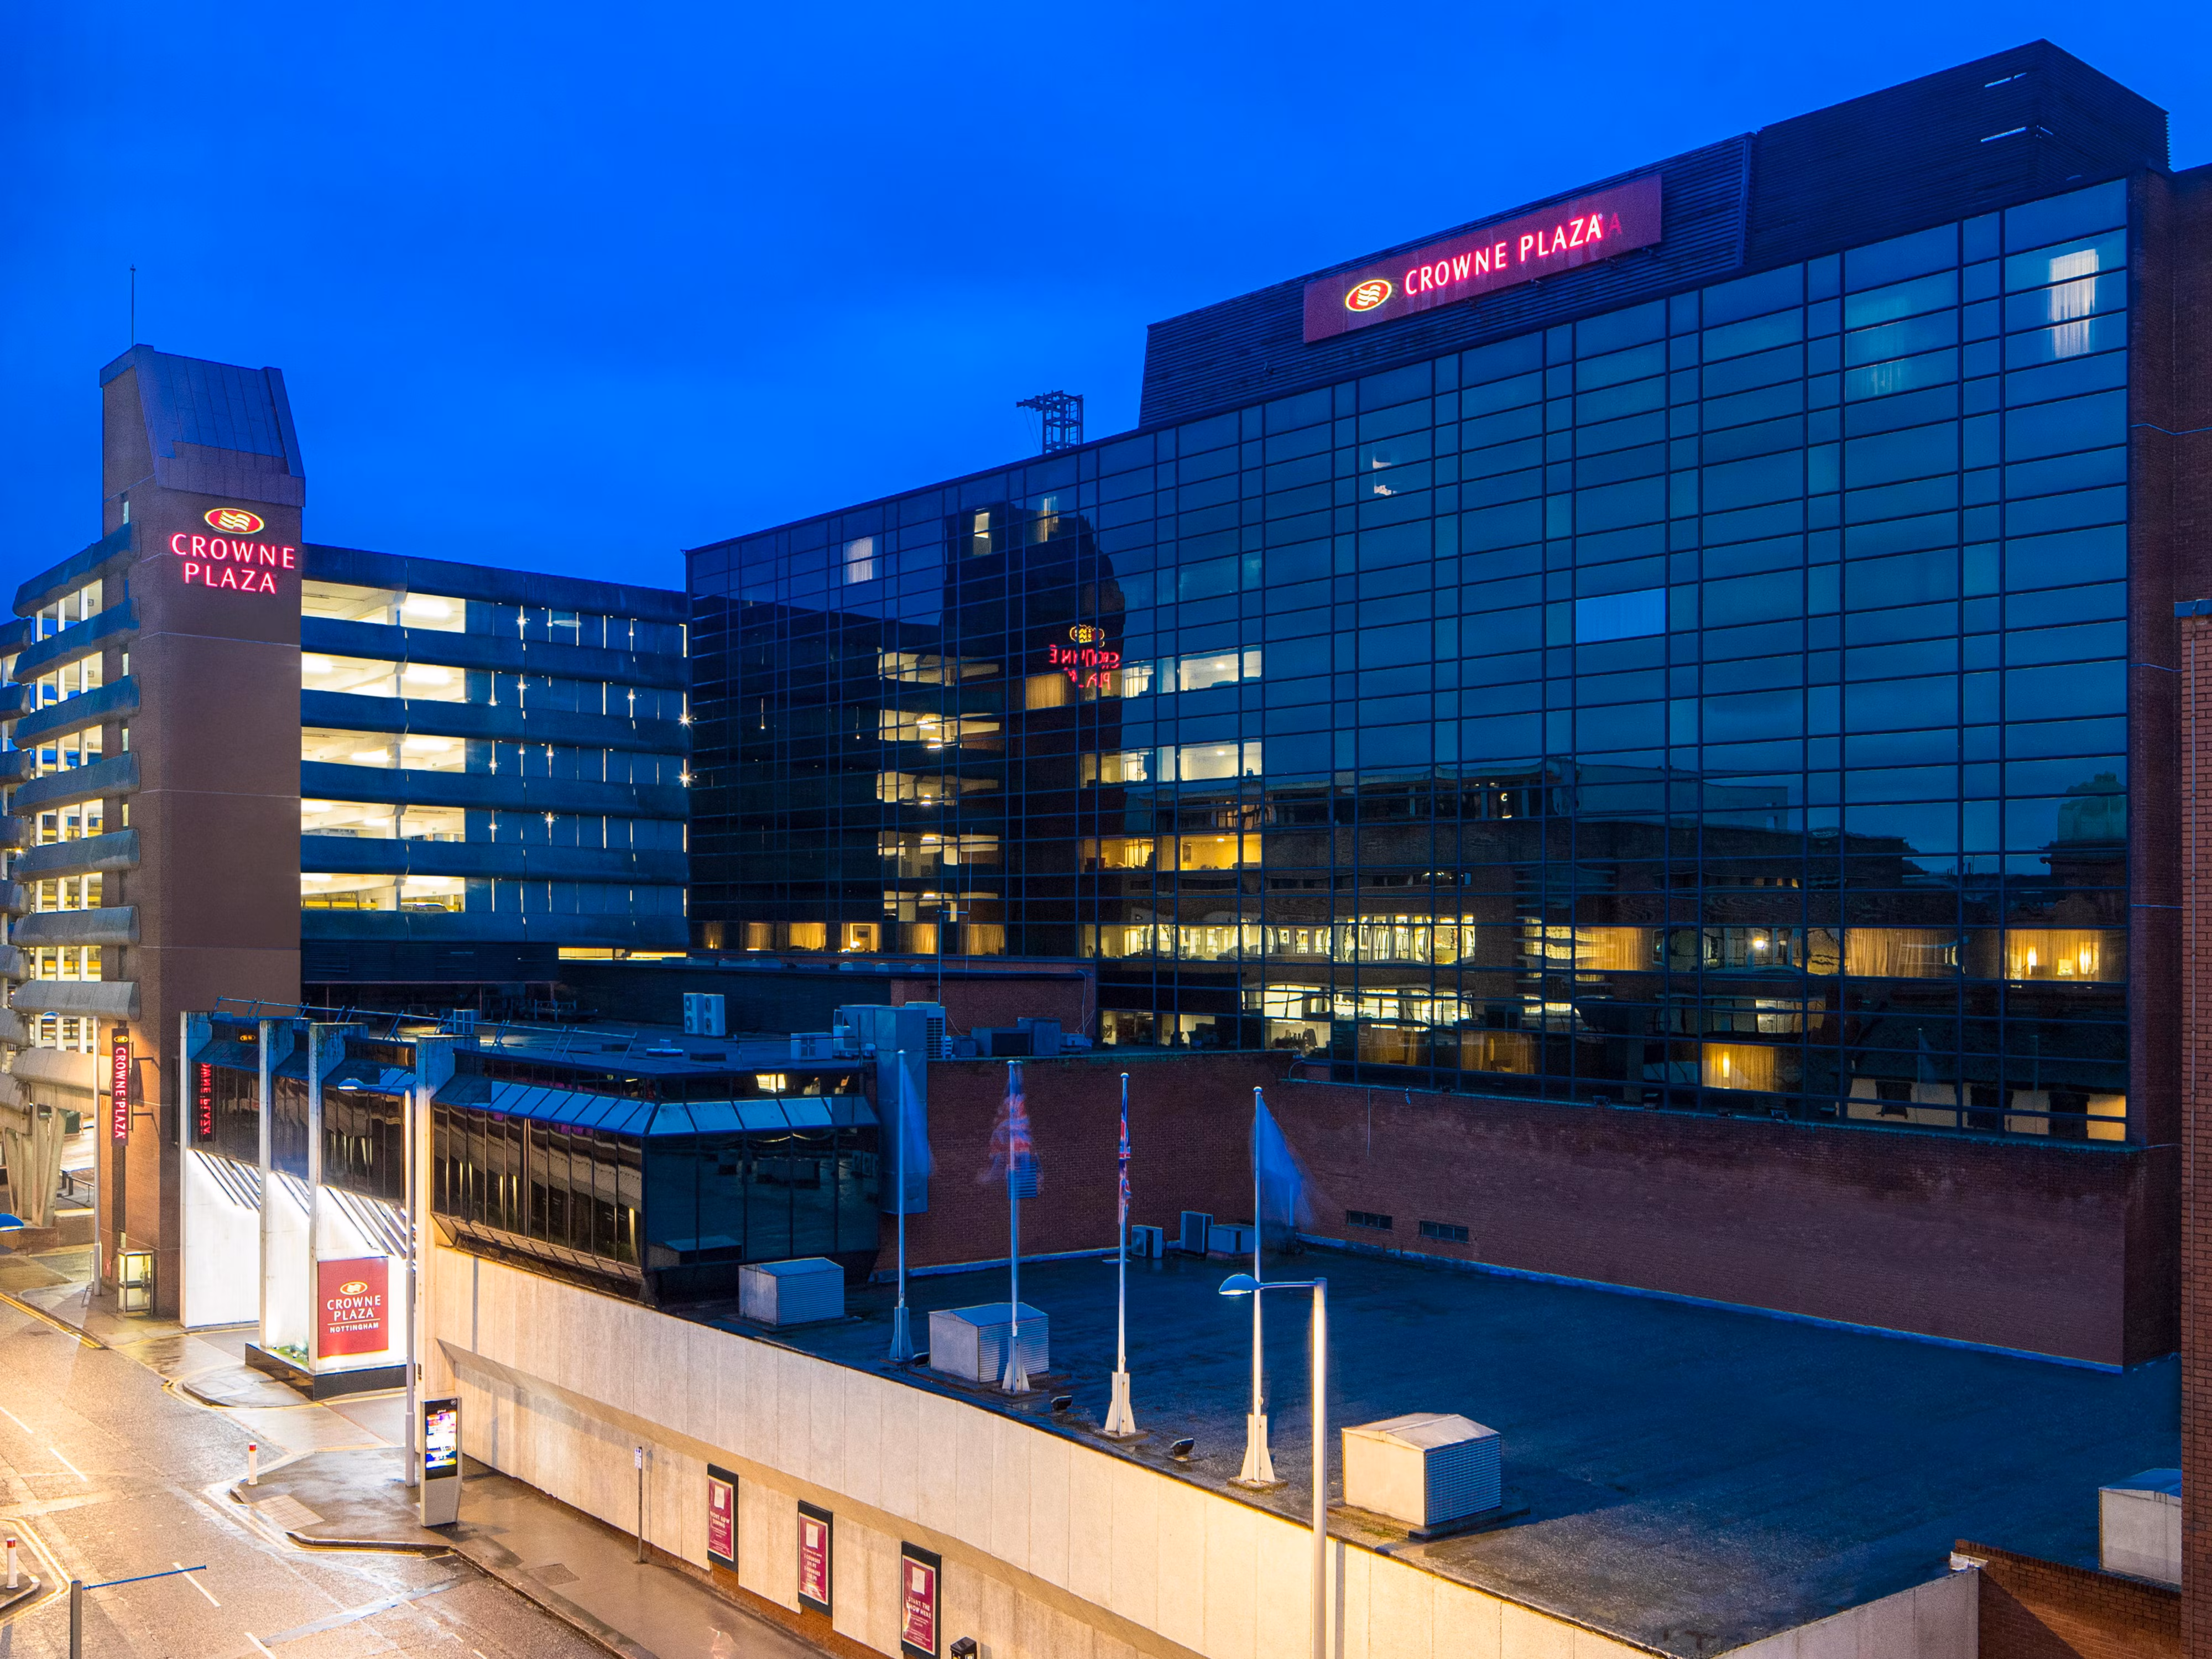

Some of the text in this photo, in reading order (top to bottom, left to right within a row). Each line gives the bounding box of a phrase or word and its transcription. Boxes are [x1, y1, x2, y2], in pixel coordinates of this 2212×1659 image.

[1405, 213, 1602, 296] CROWNE PLAZA
[171, 533, 295, 568] CROWNE
[184, 562, 275, 594] PLAZA
[114, 1047, 126, 1138] CROWNE PLAZA
[327, 1295, 381, 1310] CROWNE
[334, 1307, 374, 1321] PLAZA
[330, 1322, 379, 1333] NOTTINGHAM
[908, 1596, 921, 1606] START
